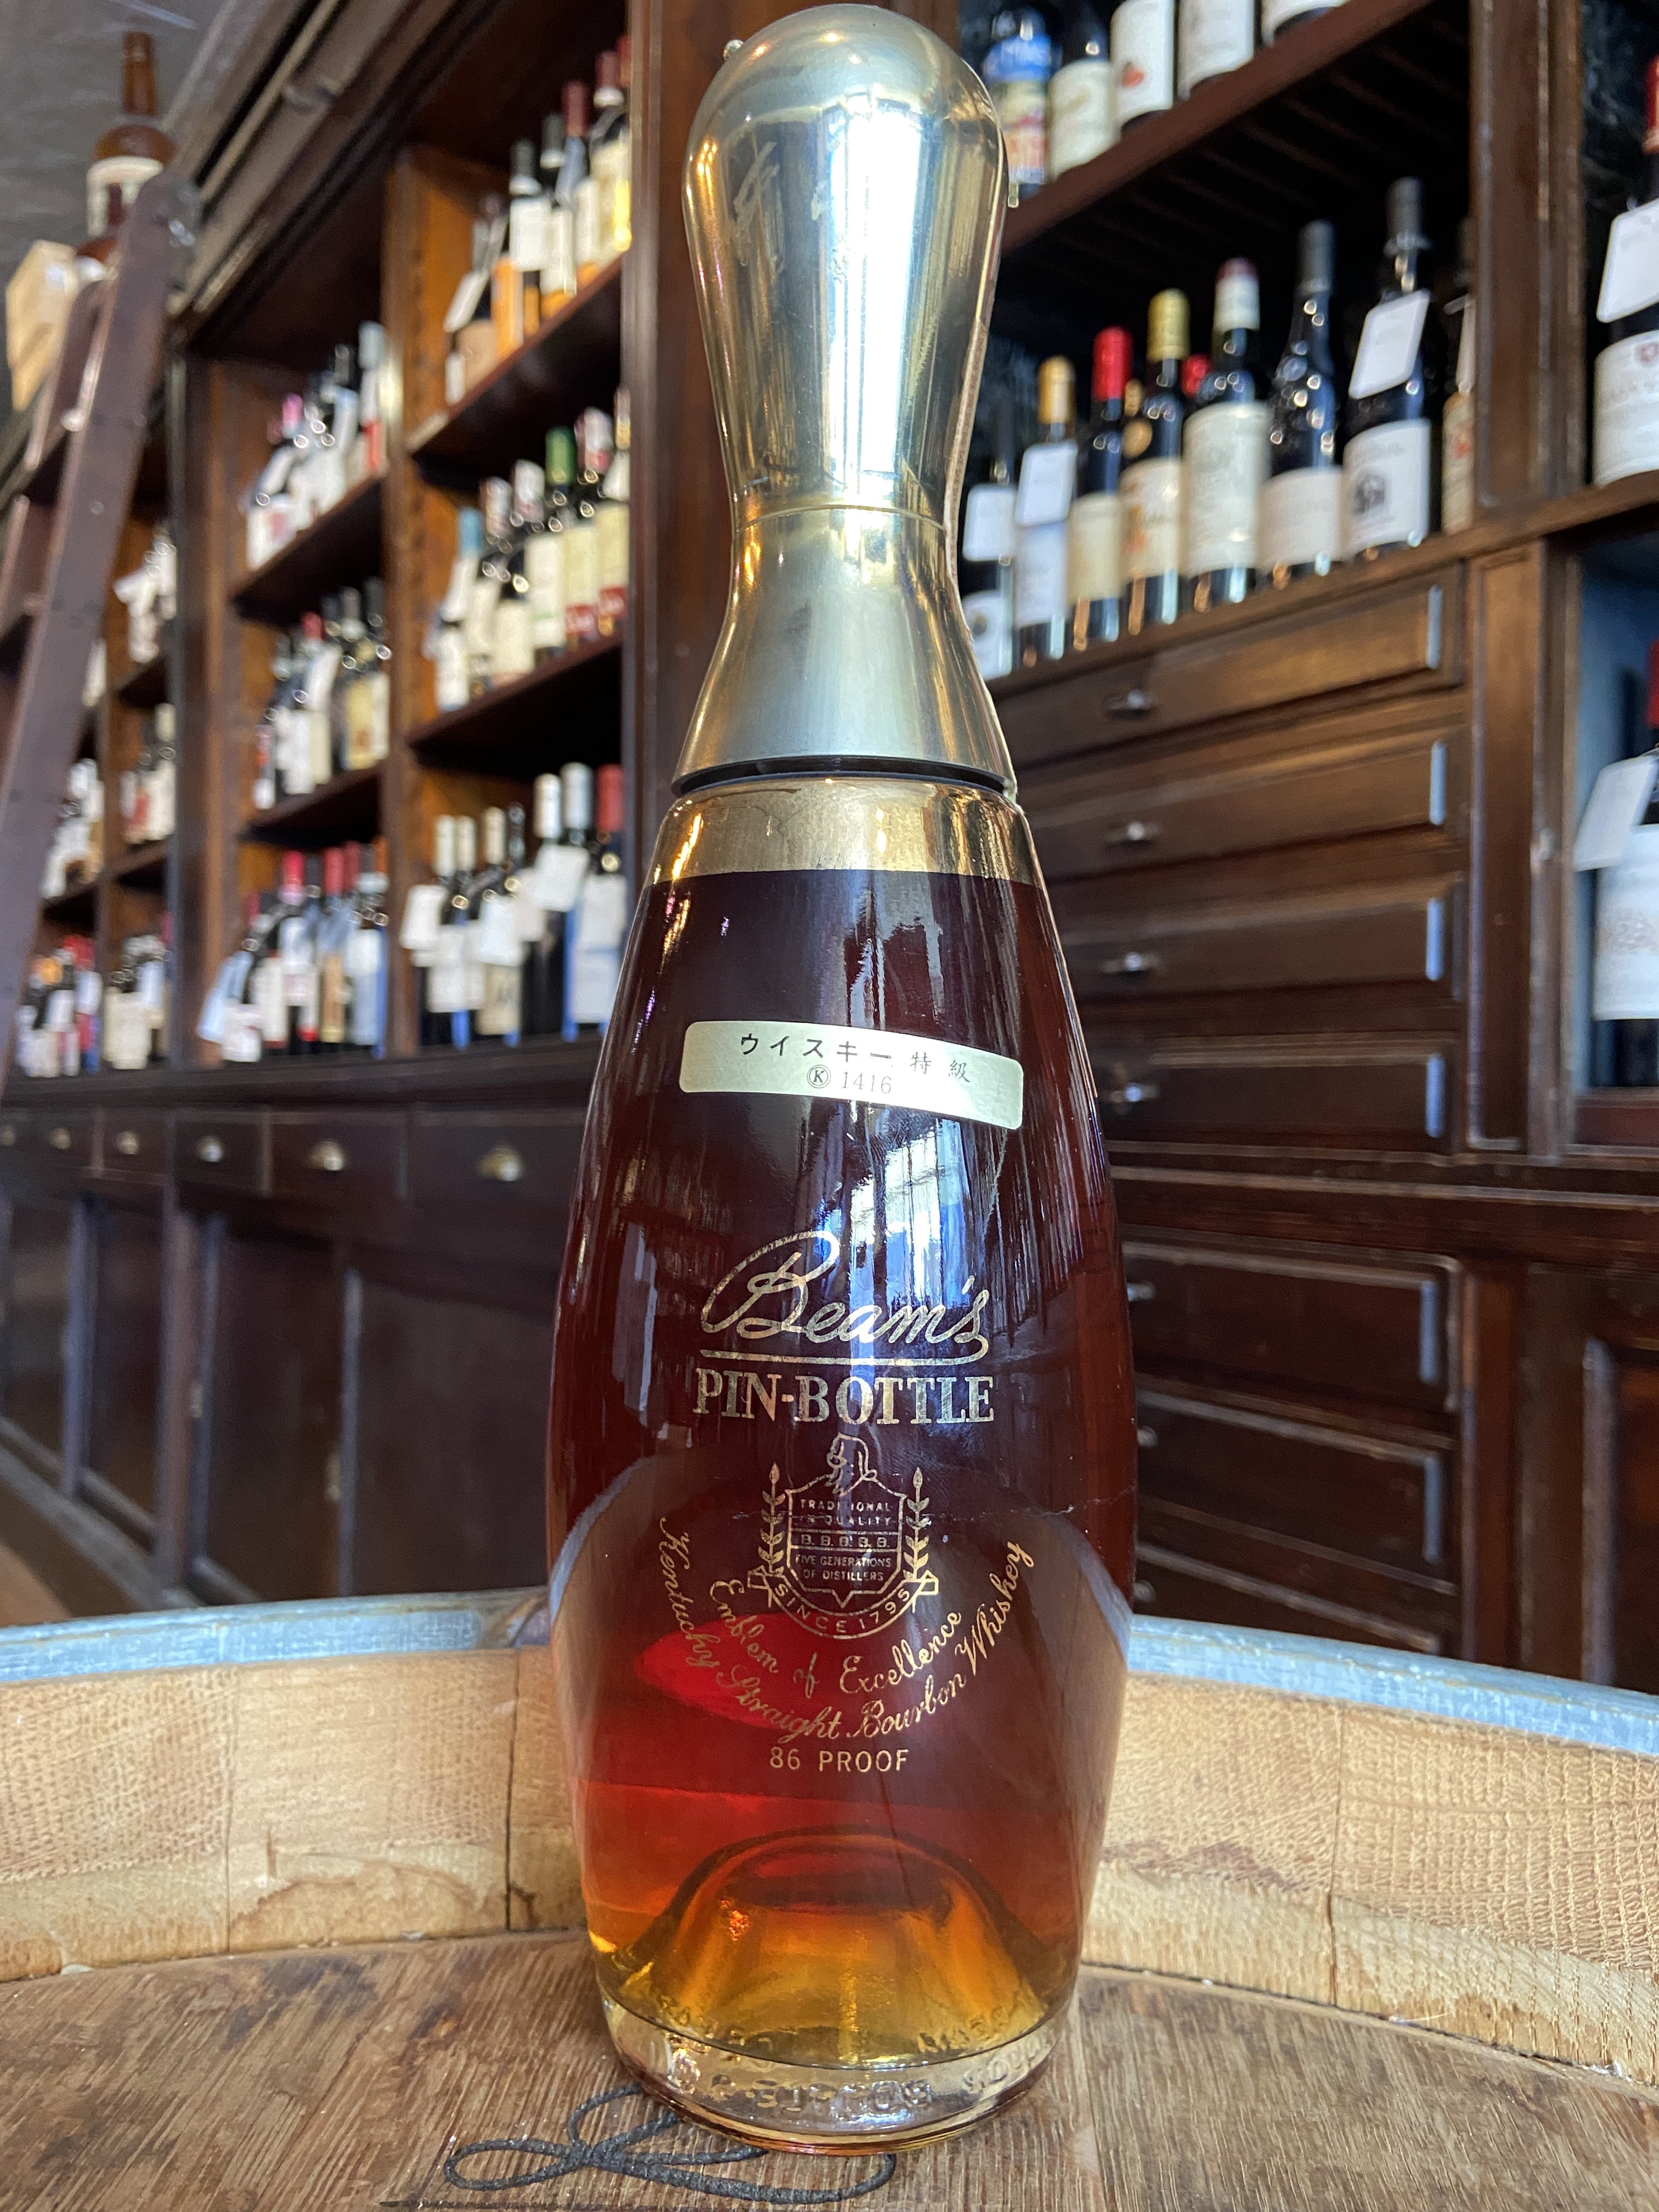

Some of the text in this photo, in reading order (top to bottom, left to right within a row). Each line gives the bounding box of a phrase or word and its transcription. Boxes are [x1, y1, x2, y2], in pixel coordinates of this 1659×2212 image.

[740, 1033, 971, 1083] ウイスキー特級
[842, 1071, 892, 1094] 1416
[701, 1230, 990, 1350] Beam's
[692, 1367, 995, 1425] PIN-BOTTLE
[795, 1554, 891, 1567] FIVE GENERATIONS
[804, 1569, 884, 1581] OF DISTILLERS
[659, 1517, 1035, 1743] Kentucky Straight Bourbon Whiskey
[775, 1583, 910, 1633] SINCE 1795
[710, 1579, 962, 1699] Emblem of Excellence
[770, 1746, 909, 1773] 86 PROOF
